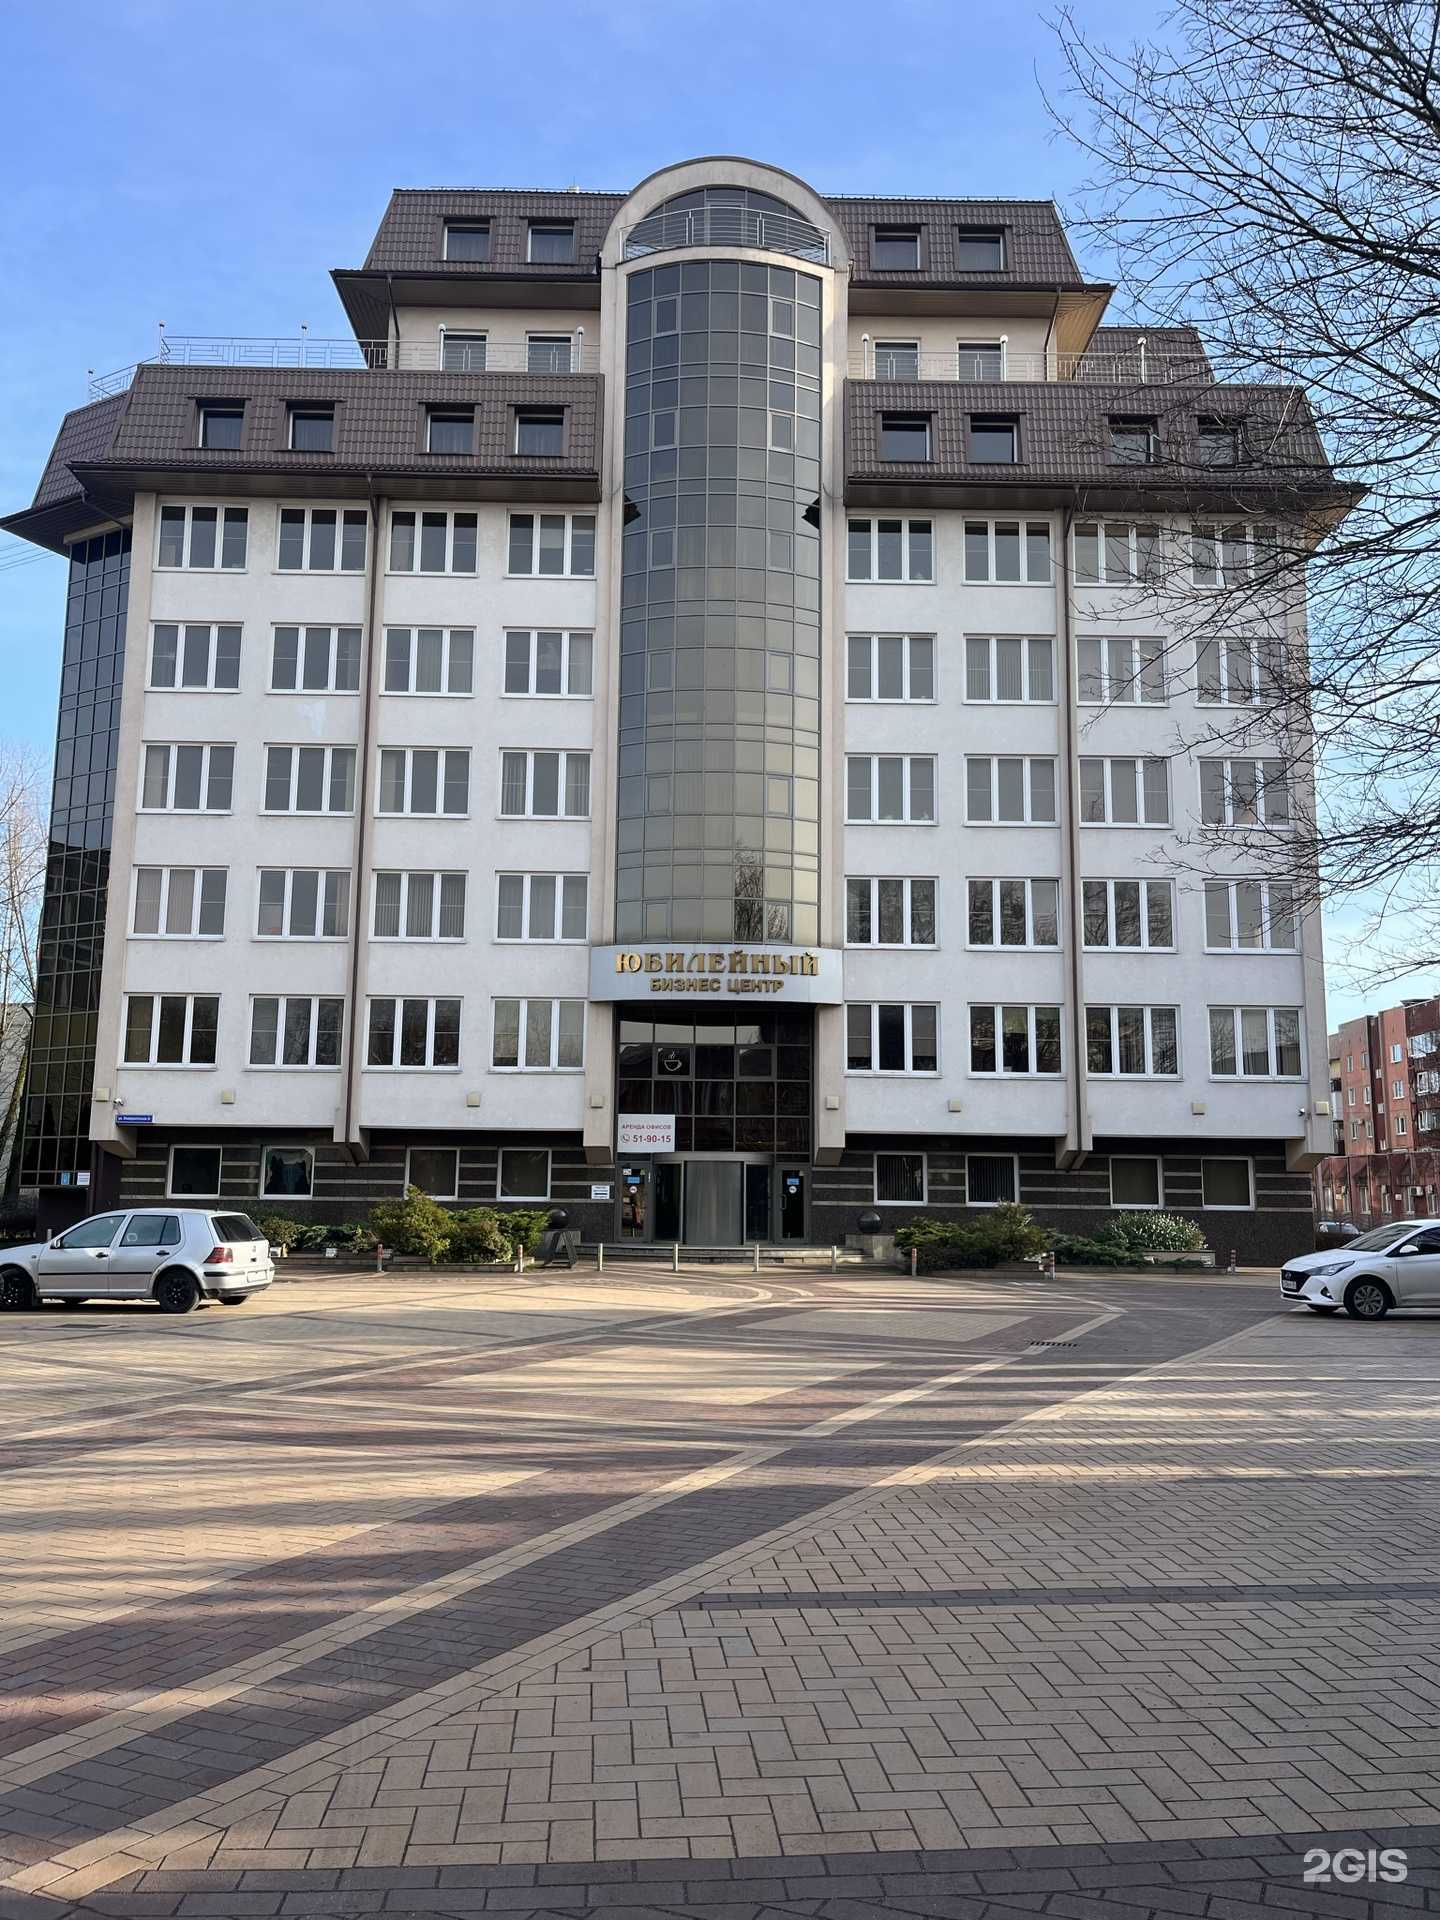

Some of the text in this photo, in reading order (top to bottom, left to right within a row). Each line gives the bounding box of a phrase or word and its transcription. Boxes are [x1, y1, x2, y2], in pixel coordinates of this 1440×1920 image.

[615, 950, 819, 976] ЮБИЛЕЙНЫЙ
[650, 978, 785, 994] БИЗНЕС ЦЕНТР
[632, 1134, 672, 1143] 51-90-15
